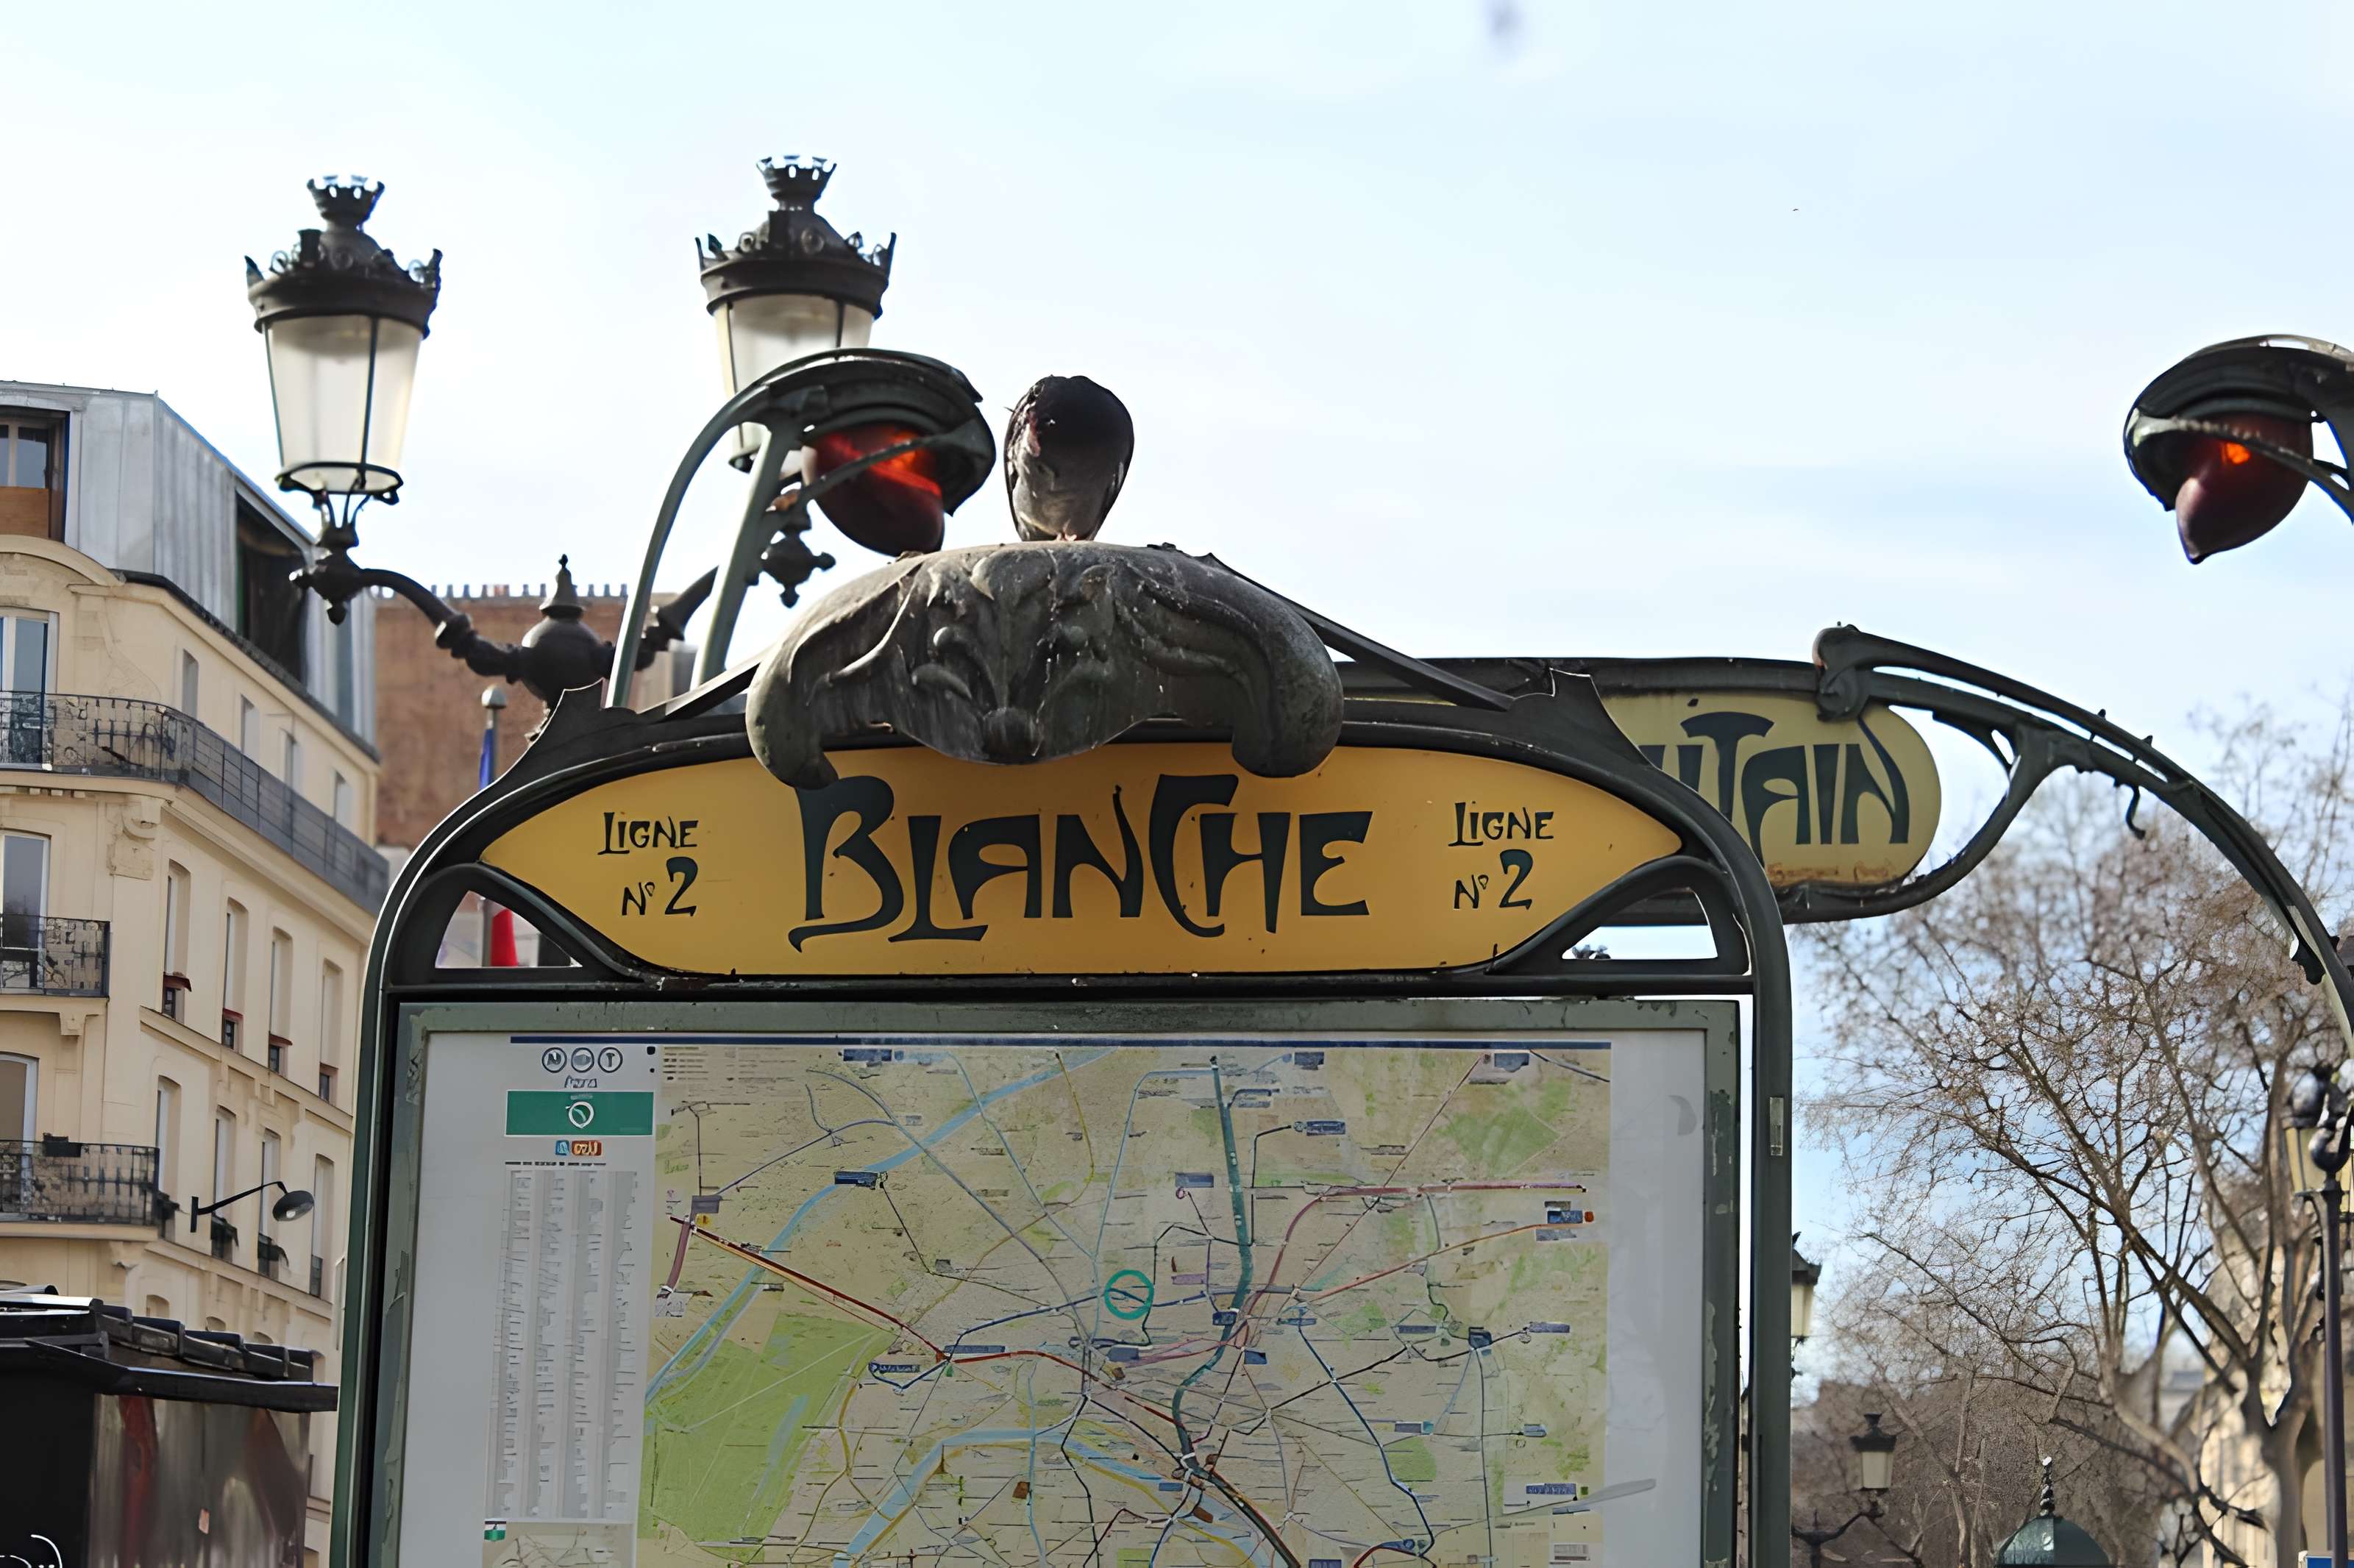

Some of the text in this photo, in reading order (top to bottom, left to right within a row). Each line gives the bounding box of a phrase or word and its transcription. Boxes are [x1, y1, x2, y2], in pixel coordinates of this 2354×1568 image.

[1639, 711, 1910, 868] TAIN
[597, 811, 699, 855] LIGNE
[1448, 802, 1554, 847] LIGNE
[664, 856, 699, 917] 2
[787, 773, 1373, 953] BLANCHE
[1498, 849, 1534, 910] 2
